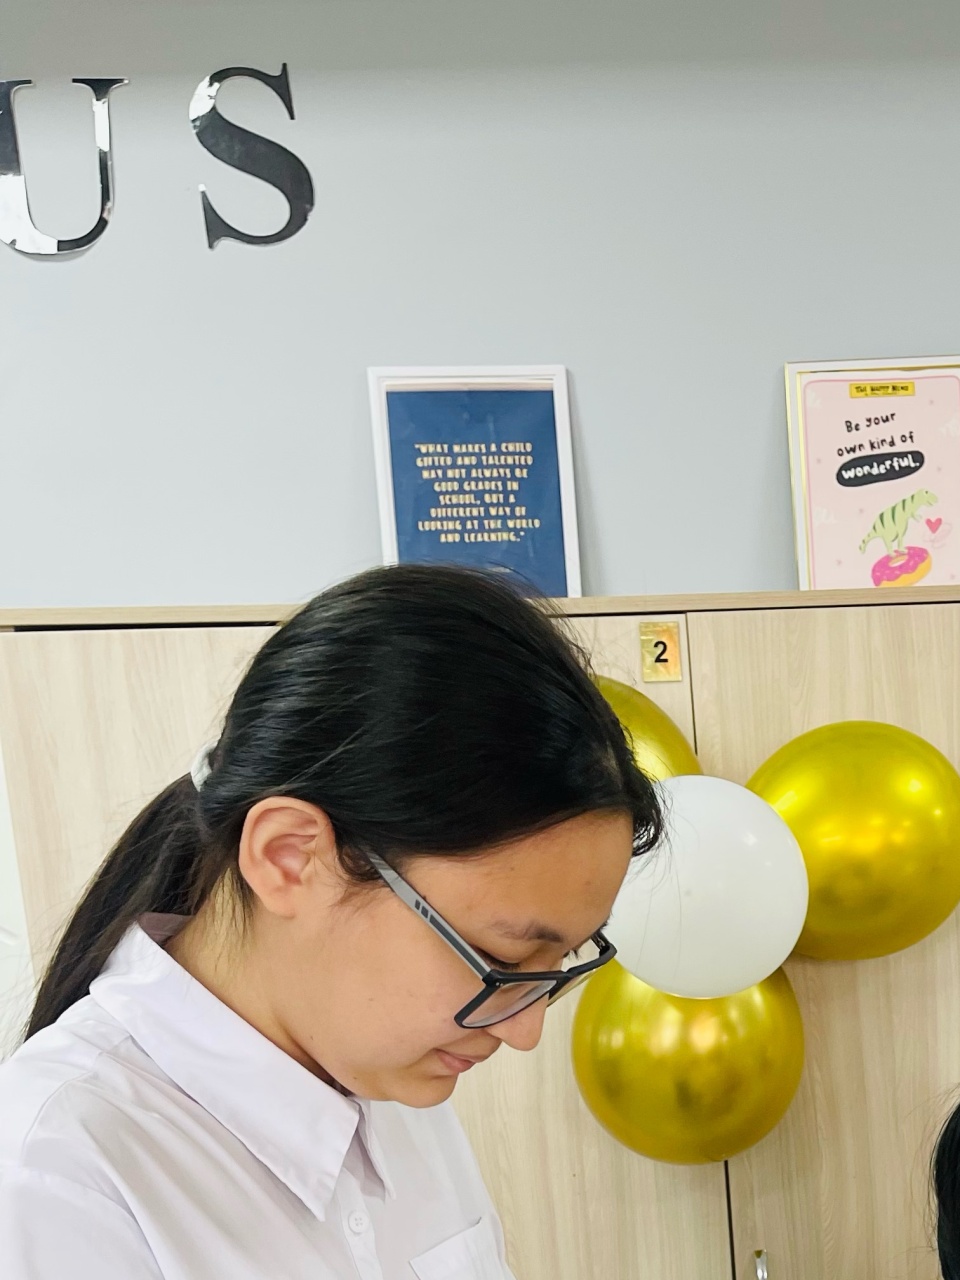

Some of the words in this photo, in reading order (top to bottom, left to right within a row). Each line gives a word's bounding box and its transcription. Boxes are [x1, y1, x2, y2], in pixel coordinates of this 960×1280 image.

[844, 420, 860, 433] Be
[865, 412, 897, 428] your
[490, 442, 497, 453] A
[501, 442, 533, 453] CHILD
[837, 443, 865, 457] own
[868, 435, 896, 452] kind
[900, 431, 916, 444] of
[416, 456, 453, 467] GIFTED
[456, 456, 478, 466] AND
[482, 455, 534, 466] TALENTED
[840, 453, 921, 480] wonderful.
[422, 468, 444, 479] MAY
[446, 468, 467, 479] NOT
[470, 467, 511, 479] ALWAYS
[515, 467, 529, 478] BE
[433, 481, 460, 492] GOOD
[463, 481, 503, 491] GRADES
[507, 480, 520, 491] IN
[438, 494, 481, 506] SCHOOL,
[484, 493, 504, 504] BUT
[509, 493, 516, 504] A
[430, 507, 485, 518] DIFFERENT
[489, 506, 511, 517] WAY
[418, 520, 462, 531] LOOKING
[466, 519, 479, 530] AT
[484, 519, 503, 529] THE
[507, 518, 541, 529] WORLD
[440, 533, 461, 543] AND
[653, 640, 669, 664] 2
